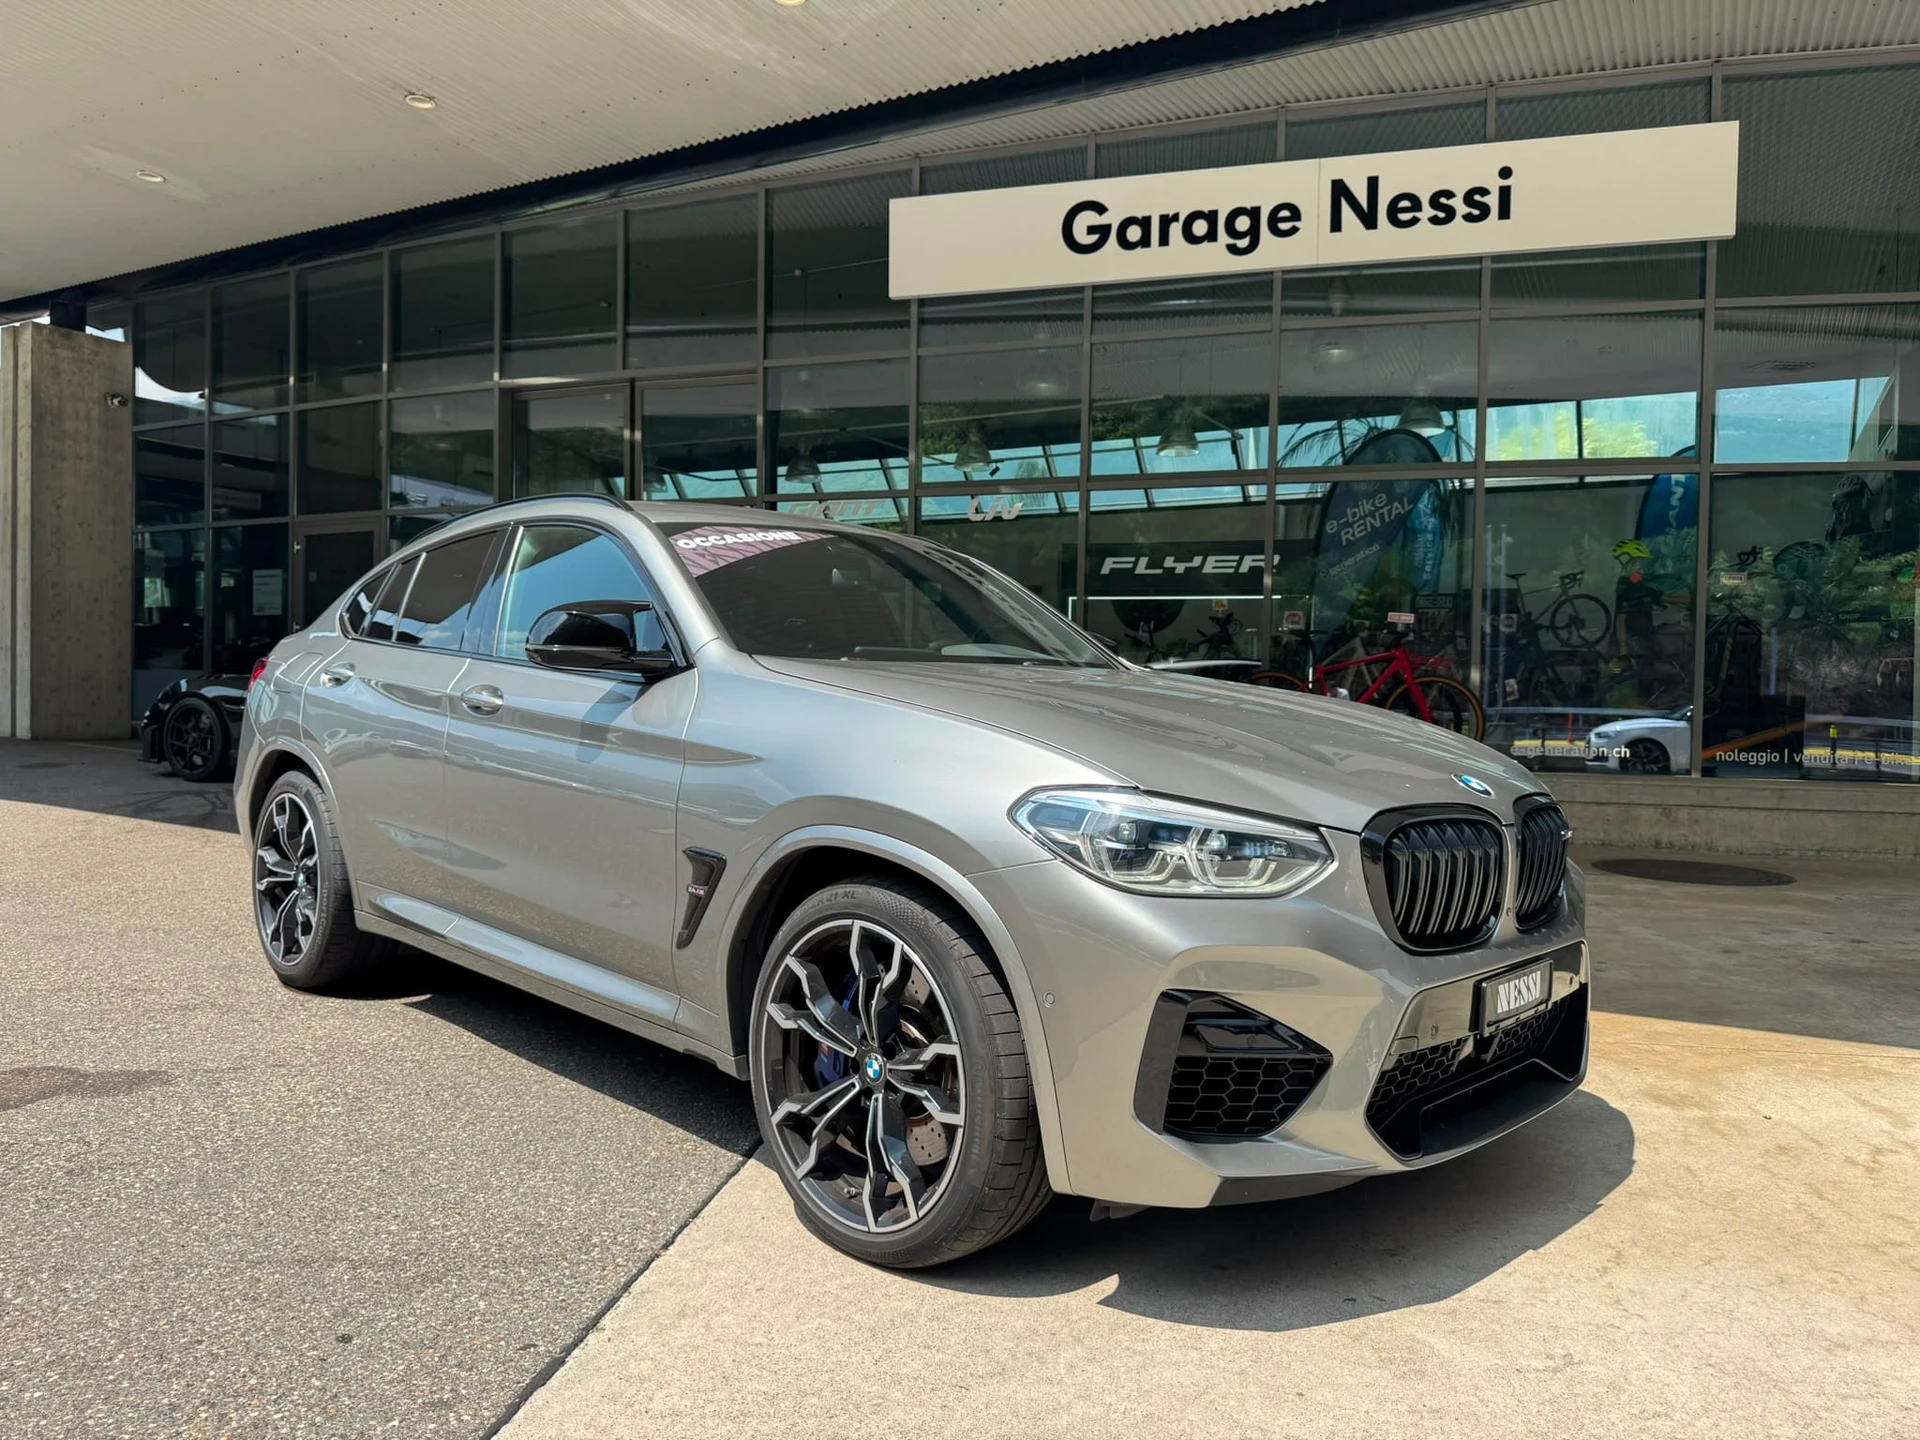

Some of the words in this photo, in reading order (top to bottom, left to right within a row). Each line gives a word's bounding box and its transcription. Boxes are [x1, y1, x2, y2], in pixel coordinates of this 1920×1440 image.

[1061, 200, 1302, 257] Garage
[1329, 165, 1514, 234] Nessi
[1326, 493, 1387, 533] e-bike
[1340, 497, 1414, 546] RENTAL
[676, 531, 802, 549] OCCASIONE
[1510, 745, 1631, 759] e-generation.ch
[1716, 748, 1780, 765] noleggio
[1794, 750, 1848, 765] vendita
[1497, 970, 1541, 1014] NESSI
